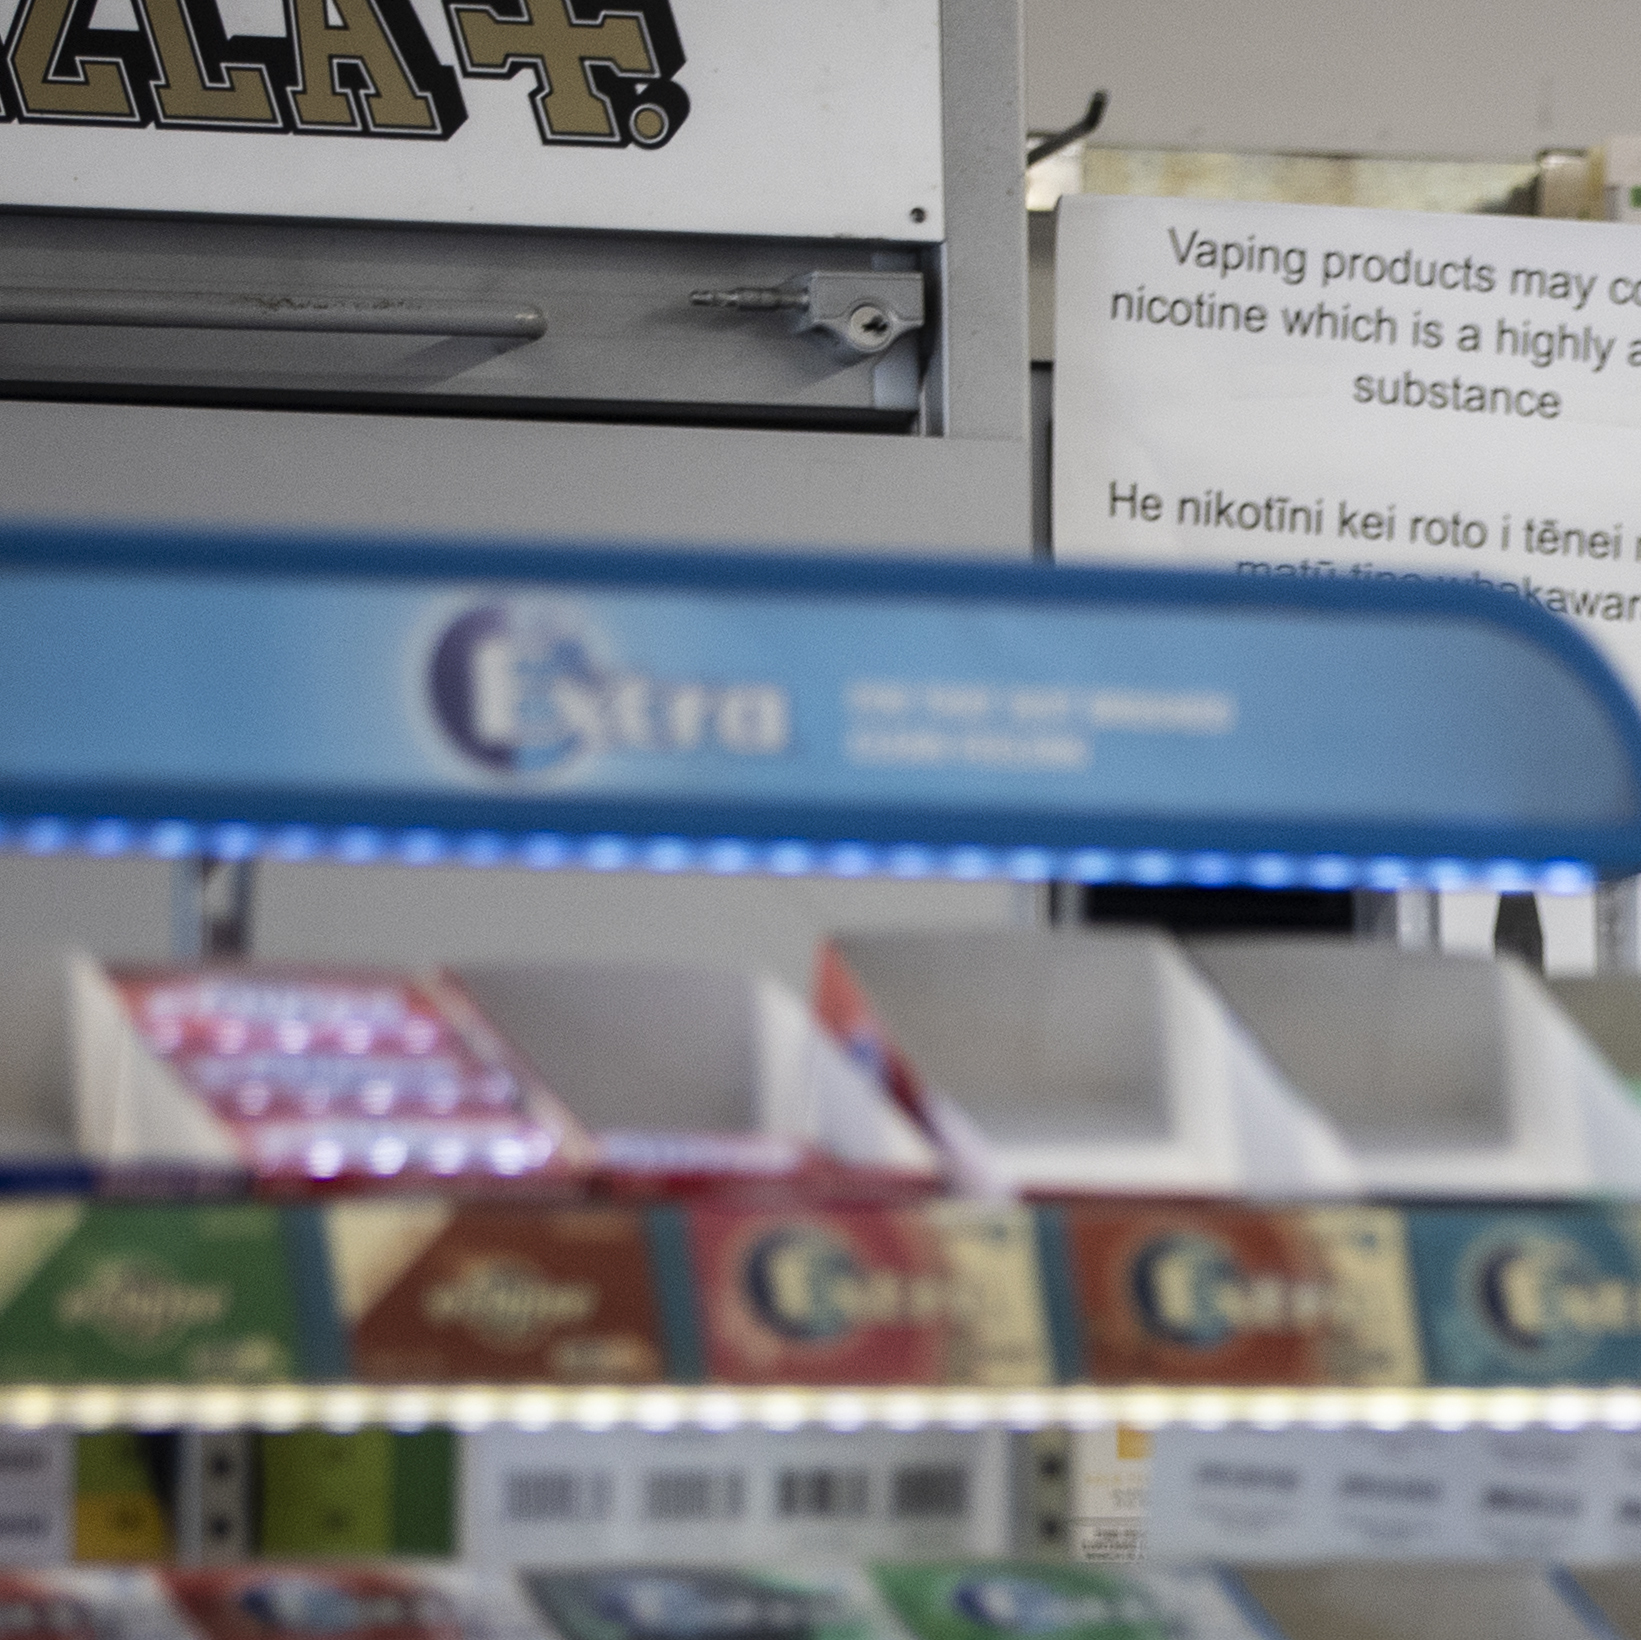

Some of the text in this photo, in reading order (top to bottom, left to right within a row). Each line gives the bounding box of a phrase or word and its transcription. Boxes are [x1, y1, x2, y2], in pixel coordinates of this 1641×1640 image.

[1167, 226, 1307, 285] Vaping
[1320, 249, 1496, 294] products
[1510, 266, 1598, 311] may
[1110, 284, 1268, 333] nicotine
[1281, 301, 1397, 346] which
[1412, 310, 1444, 349] is
[1456, 323, 1481, 352] a
[1496, 318, 1617, 374] highly
[1353, 370, 1562, 420] substance
[1108, 479, 1162, 522] He
[1177, 488, 1324, 537] nikotīni
[1338, 500, 1396, 542] kei
[1410, 510, 1489, 550] roto
[1500, 513, 1511, 552] i
[1524, 517, 1623, 562] tēnei
